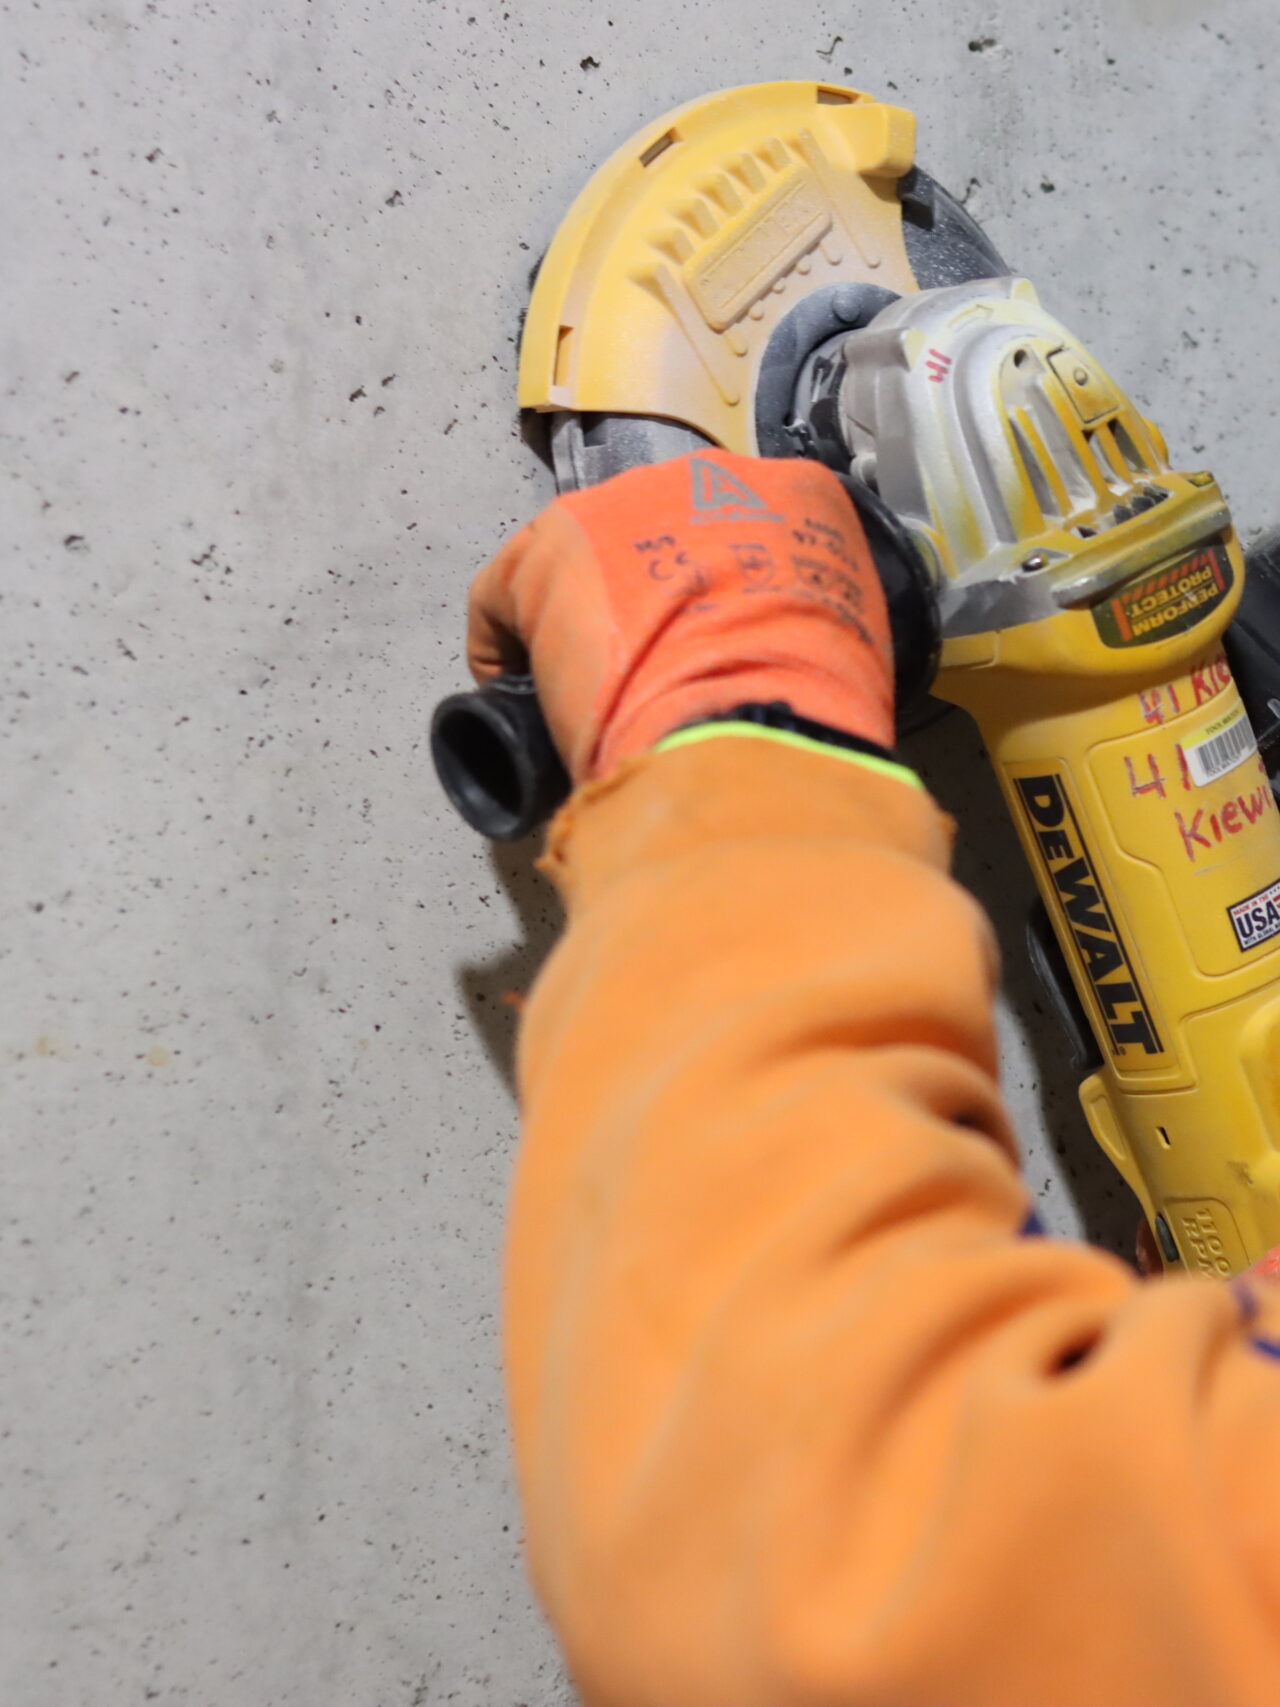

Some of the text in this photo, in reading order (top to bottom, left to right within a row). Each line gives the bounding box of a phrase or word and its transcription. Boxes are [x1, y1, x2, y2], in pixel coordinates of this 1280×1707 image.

[1131, 565, 1212, 617] PROTECT
[1132, 584, 1219, 636] PERFORM
[1138, 684, 1181, 725] 41
[1123, 743, 1192, 799] 41
[1016, 774, 1157, 1054] DEWALT
[1236, 901, 1280, 939] USA
